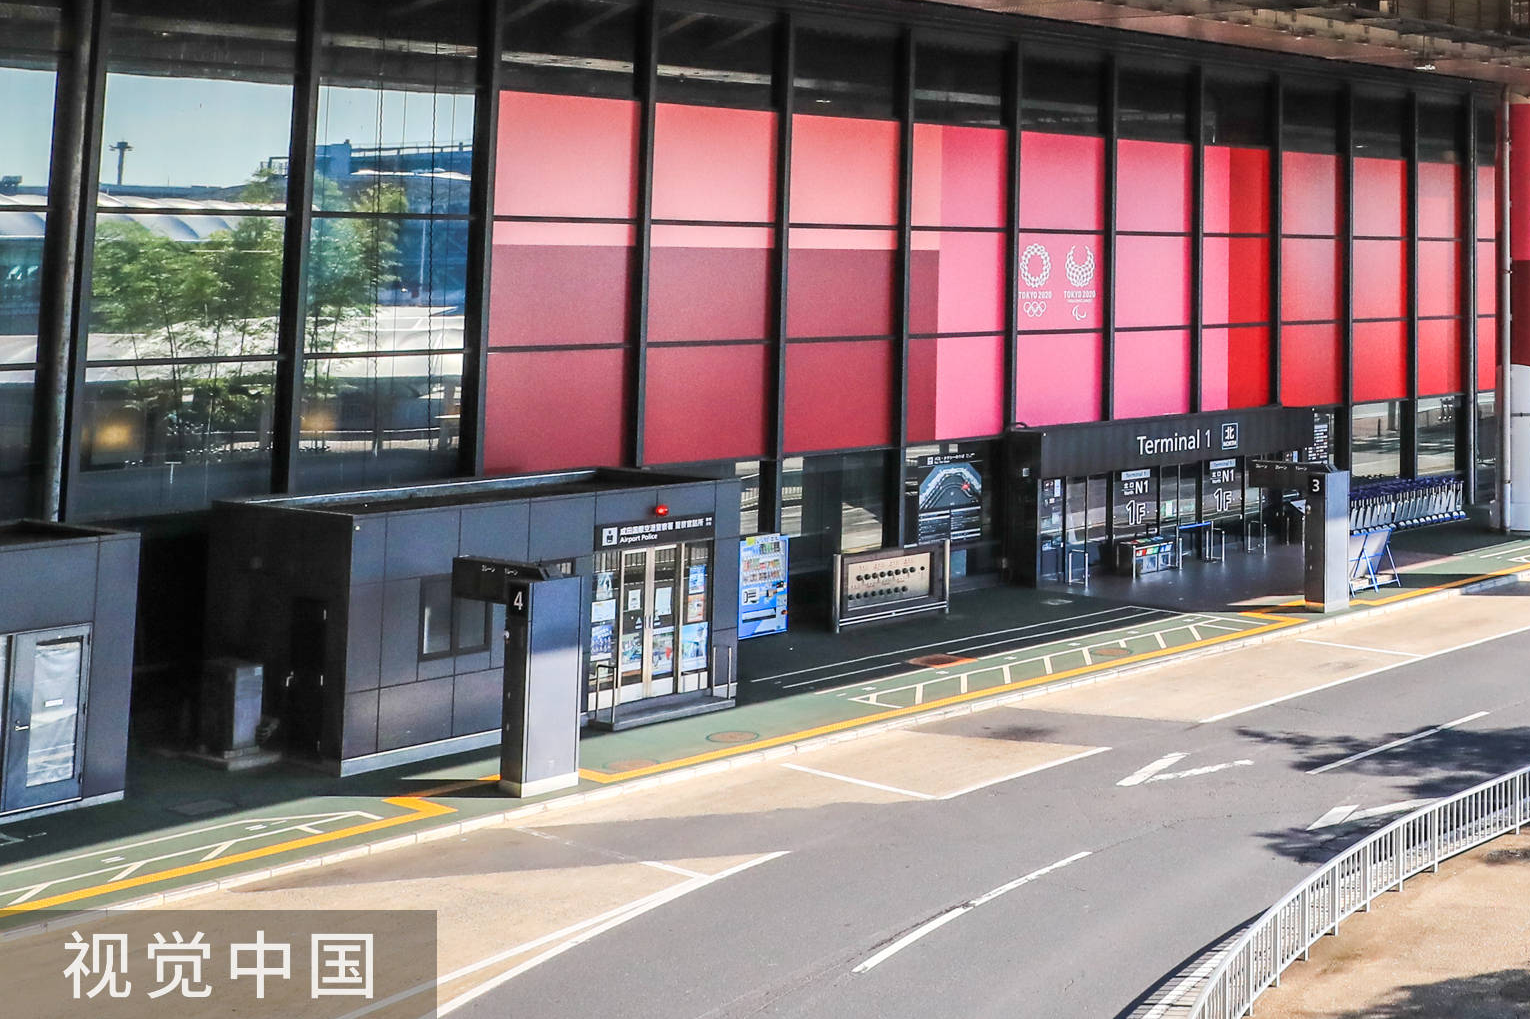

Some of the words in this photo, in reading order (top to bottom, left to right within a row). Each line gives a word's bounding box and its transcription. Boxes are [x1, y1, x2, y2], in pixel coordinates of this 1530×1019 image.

[1018, 291, 1038, 300] TOKYO
[1038, 290, 1053, 299] 2020
[1064, 290, 1081, 299] TOKYO
[1081, 290, 1096, 298] 2020
[1224, 426, 1235, 440] 北
[1136, 428, 1200, 456] Terminal
[1204, 430, 1211, 448] 1
[1222, 469, 1234, 483] N1
[1135, 480, 1149, 494] N1
[1312, 479, 1320, 492] 3
[1213, 487, 1233, 512] 1F
[1125, 499, 1146, 526] 1F
[619, 535, 641, 545] Airport
[641, 532, 658, 541] Police
[513, 591, 524, 611] 4
